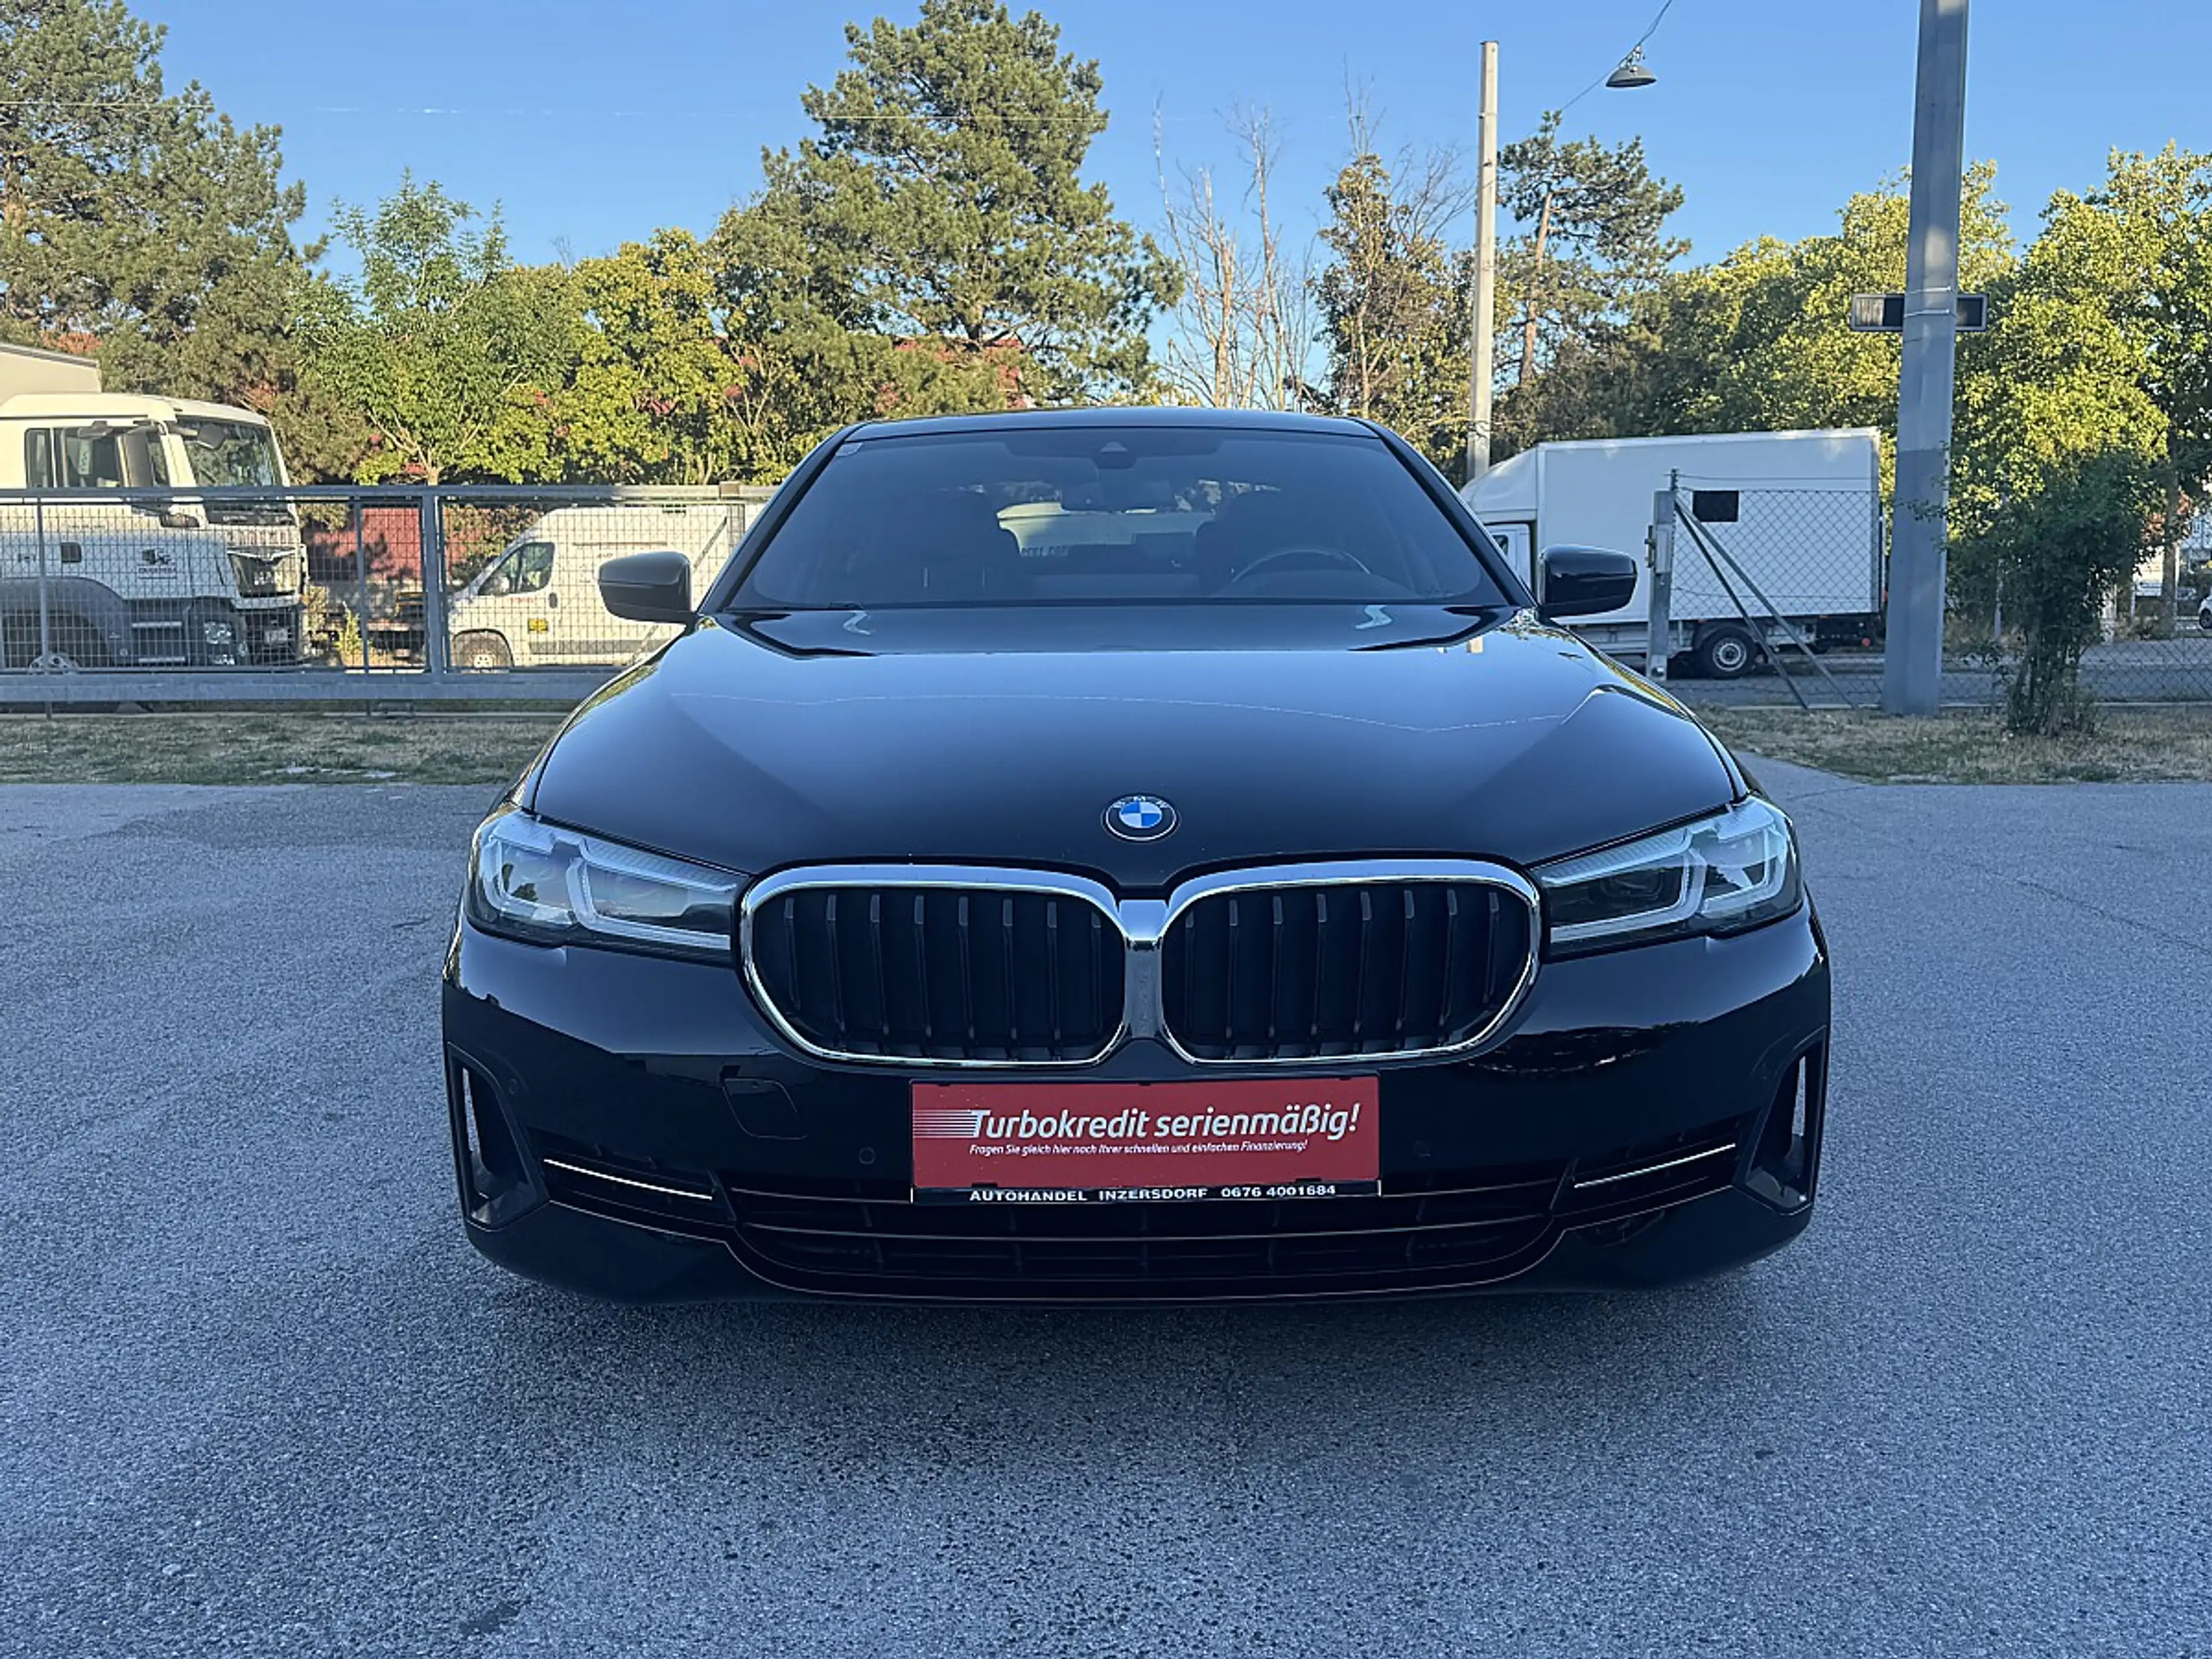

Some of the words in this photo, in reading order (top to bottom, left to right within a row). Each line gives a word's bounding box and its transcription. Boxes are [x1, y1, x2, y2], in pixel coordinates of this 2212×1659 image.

[970, 1108, 1150, 1138] Turbokredit
[1154, 1103, 1361, 1140] serienmäßig!
[969, 1144, 1003, 1157] Fragen
[1005, 1144, 1020, 1154] Sie
[1021, 1144, 1051, 1157] gleich
[1052, 1144, 1072, 1154] hier
[1099, 1143, 1123, 1153] Ihrer
[1124, 1143, 1169, 1153] schnellen
[1172, 1143, 1190, 1153] und
[1192, 1141, 1239, 1153] einfachen
[1241, 1139, 1308, 1153] Finanzierung!
[969, 1190, 1088, 1201] AUTOHANDEL
[1099, 1188, 1208, 1200] INZERSDORF
[1221, 1187, 1262, 1198] 0676
[1267, 1185, 1336, 1196] 4001684
